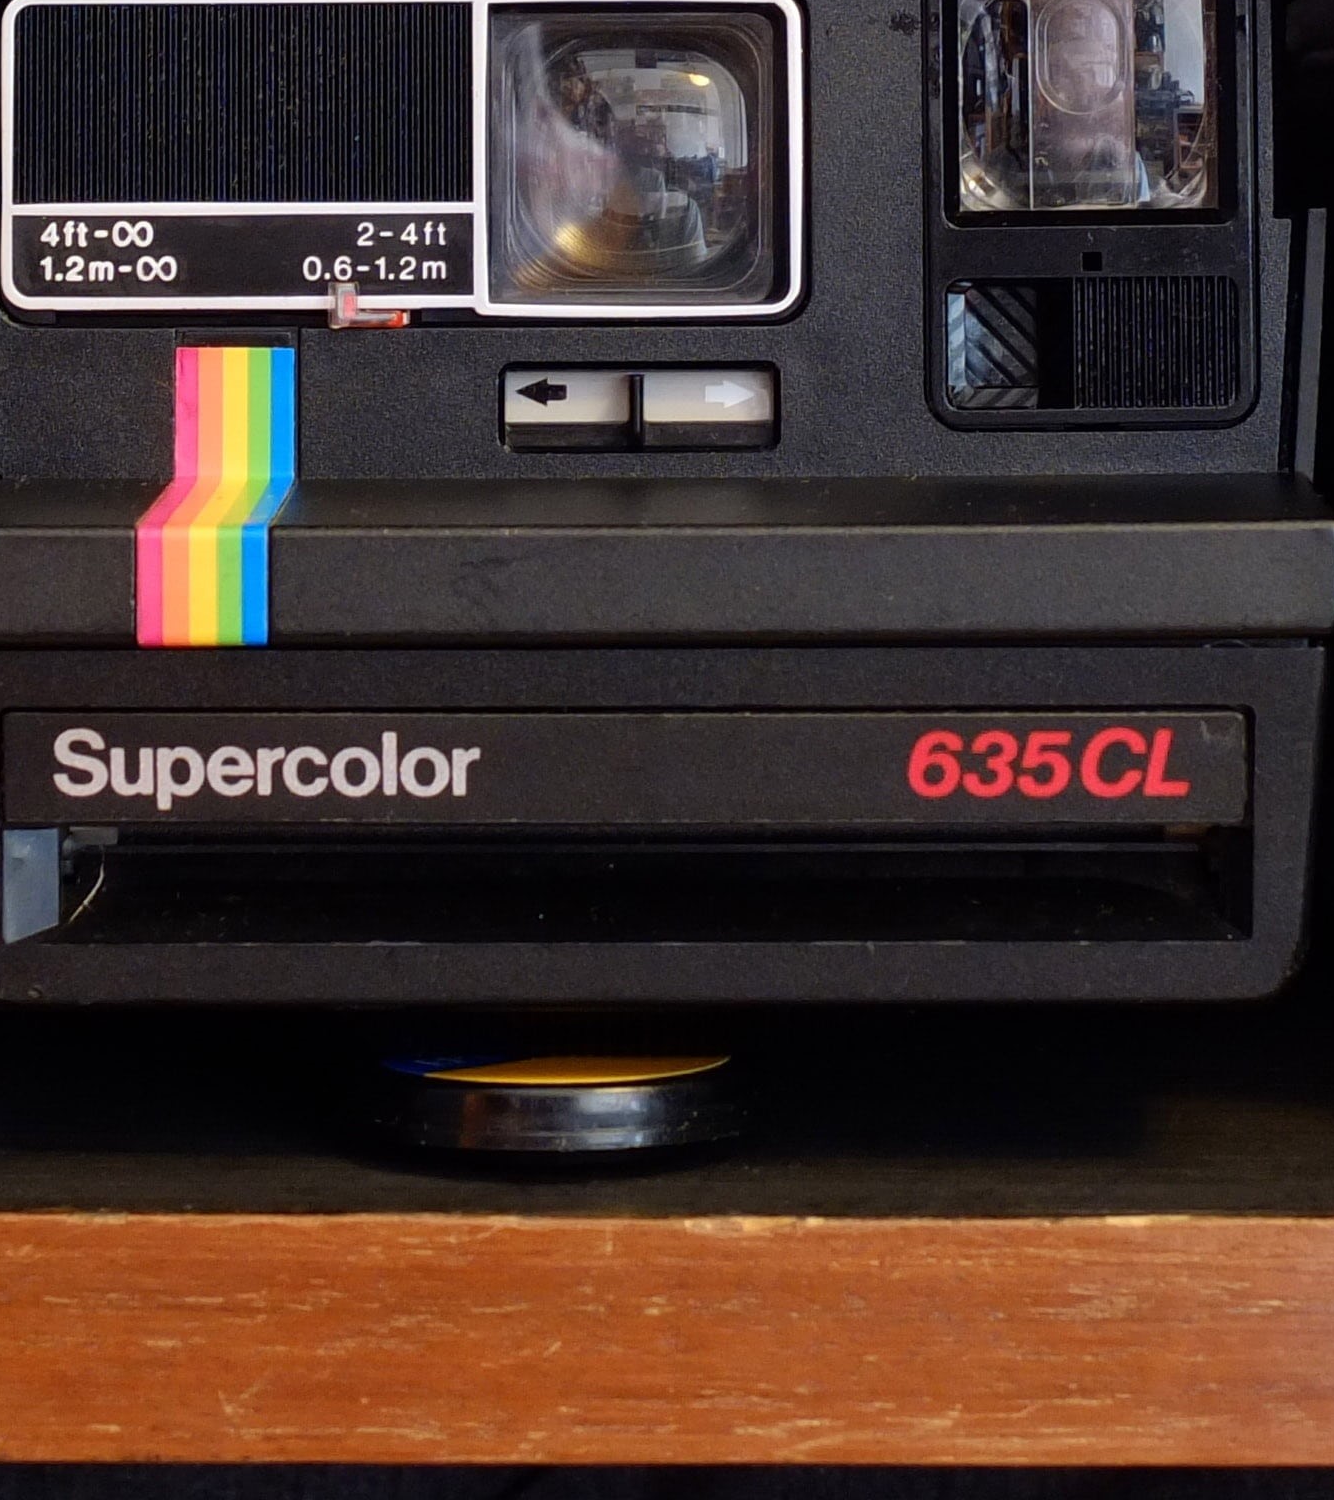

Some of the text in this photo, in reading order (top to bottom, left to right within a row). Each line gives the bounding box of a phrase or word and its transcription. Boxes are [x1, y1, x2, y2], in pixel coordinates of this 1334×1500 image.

[357, 221, 448, 248] 2-4ft
[303, 256, 448, 282] 0.6-1.2m
[54, 729, 482, 812] Supercolor
[908, 727, 1191, 800] 635CL
